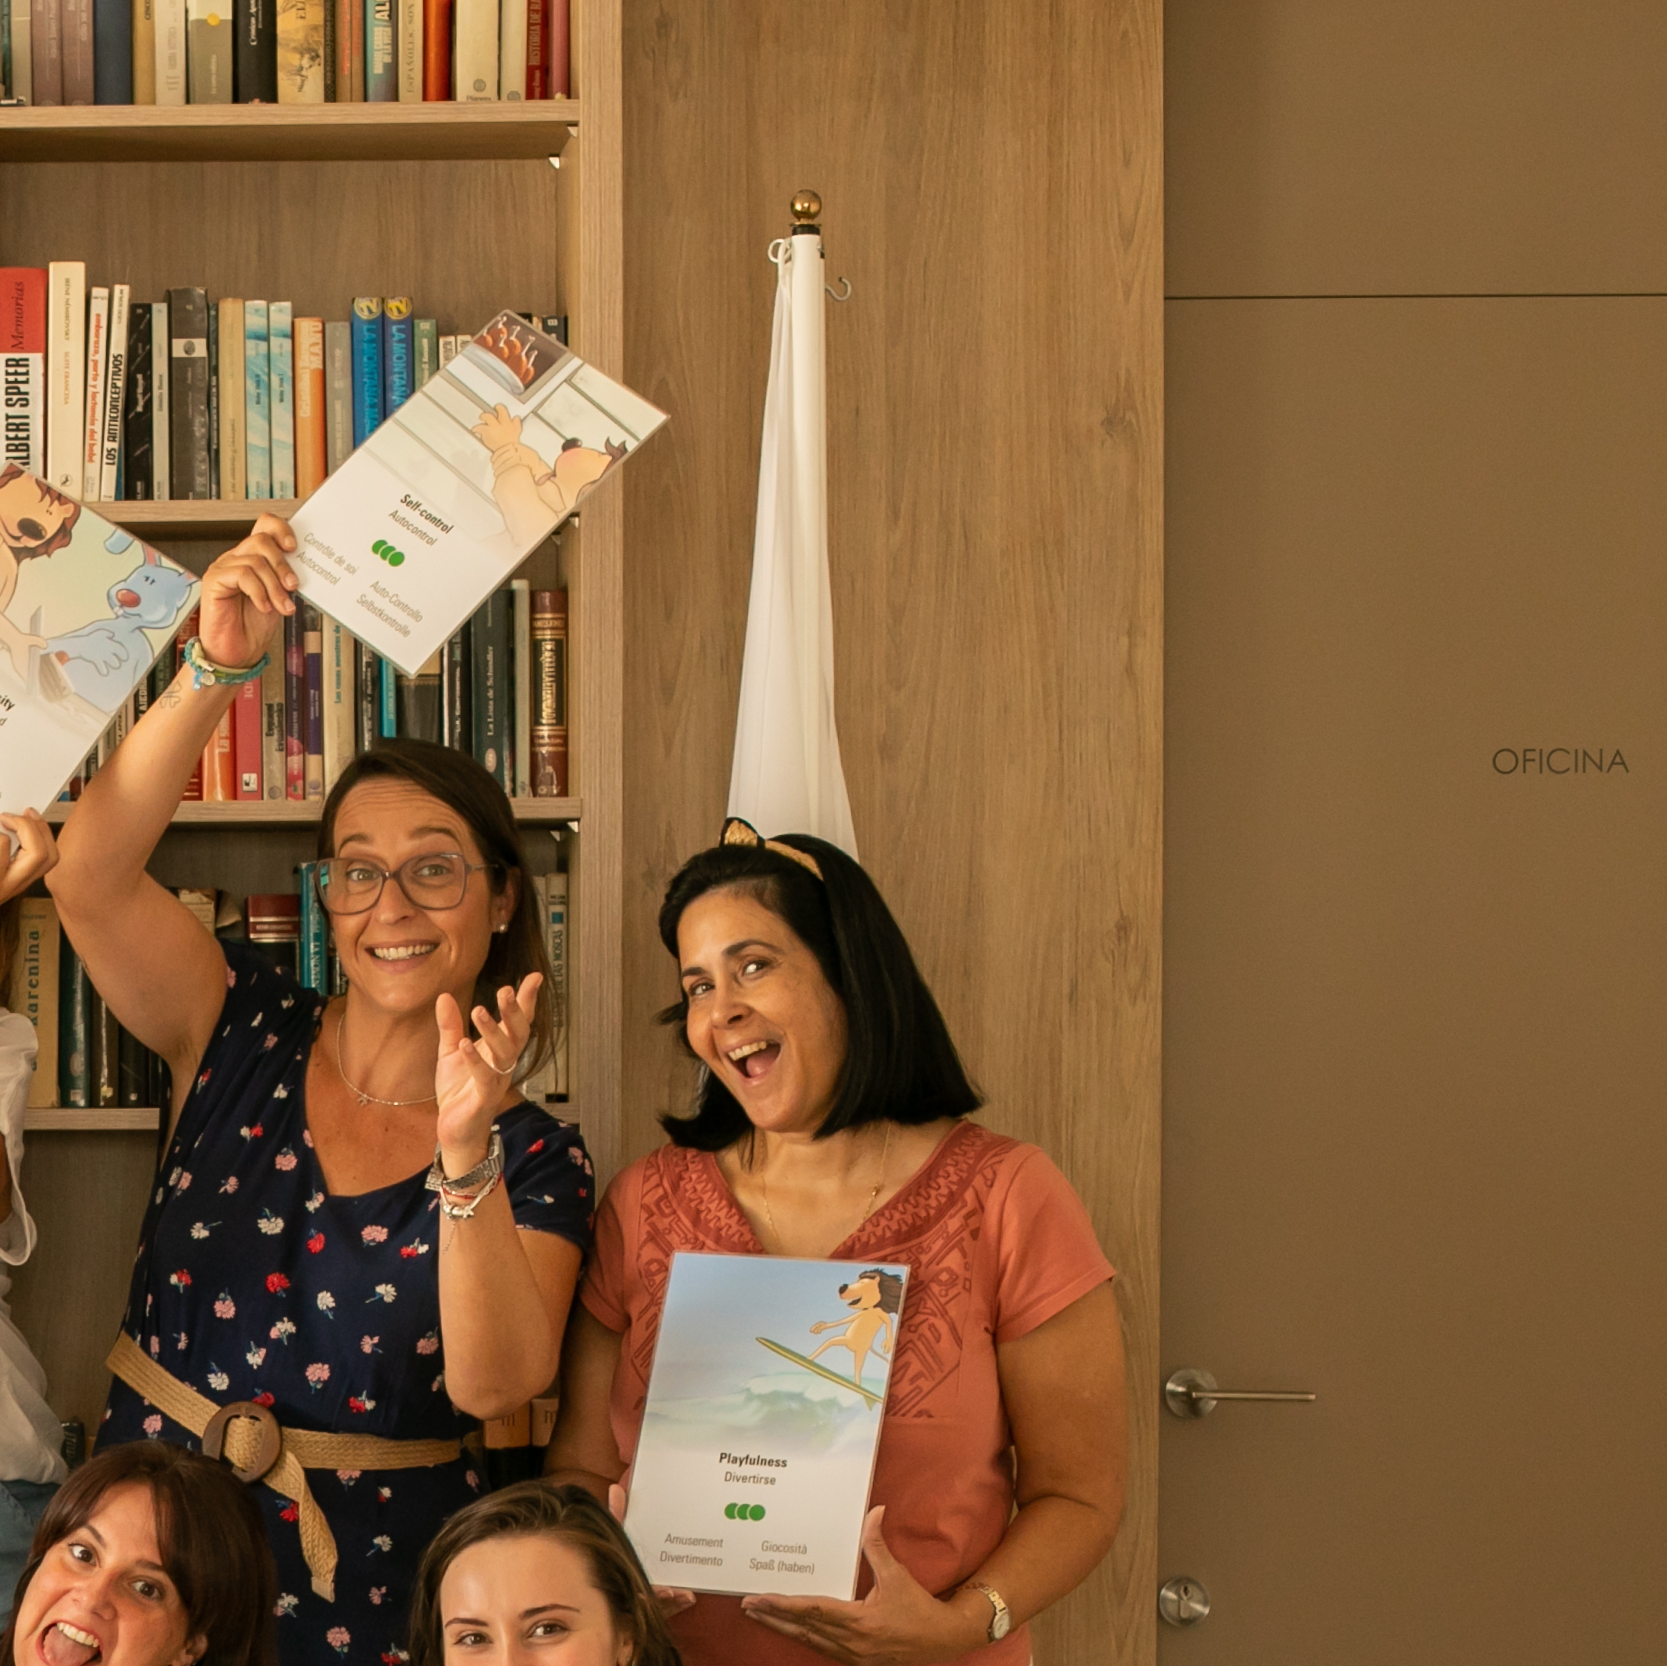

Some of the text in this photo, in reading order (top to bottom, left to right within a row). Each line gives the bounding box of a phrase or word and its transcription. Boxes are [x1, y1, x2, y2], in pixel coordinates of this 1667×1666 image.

[10, 280, 25, 351] Memorias
[5, 357, 31, 409] SPEER
[105, 352, 125, 466] LOS ANTICONCEPTIVOS
[388, 509, 439, 547] Autocontrol
[400, 493, 454, 535] Self-control
[296, 550, 341, 587] Autocontrol
[303, 531, 359, 576] Contrôle de soi
[356, 593, 412, 638] Selbstkontrolle
[370, 580, 424, 623] Auto-Controllo
[1492, 747, 1630, 775] OFICINA
[718, 1452, 788, 1469] Playfulness
[724, 1471, 777, 1486] Divertirse
[659, 1550, 723, 1567] Divertimento
[664, 1533, 724, 1549] Amusement
[761, 1540, 808, 1556] Giocosità
[749, 1558, 815, 1576] Spaß (haben)
